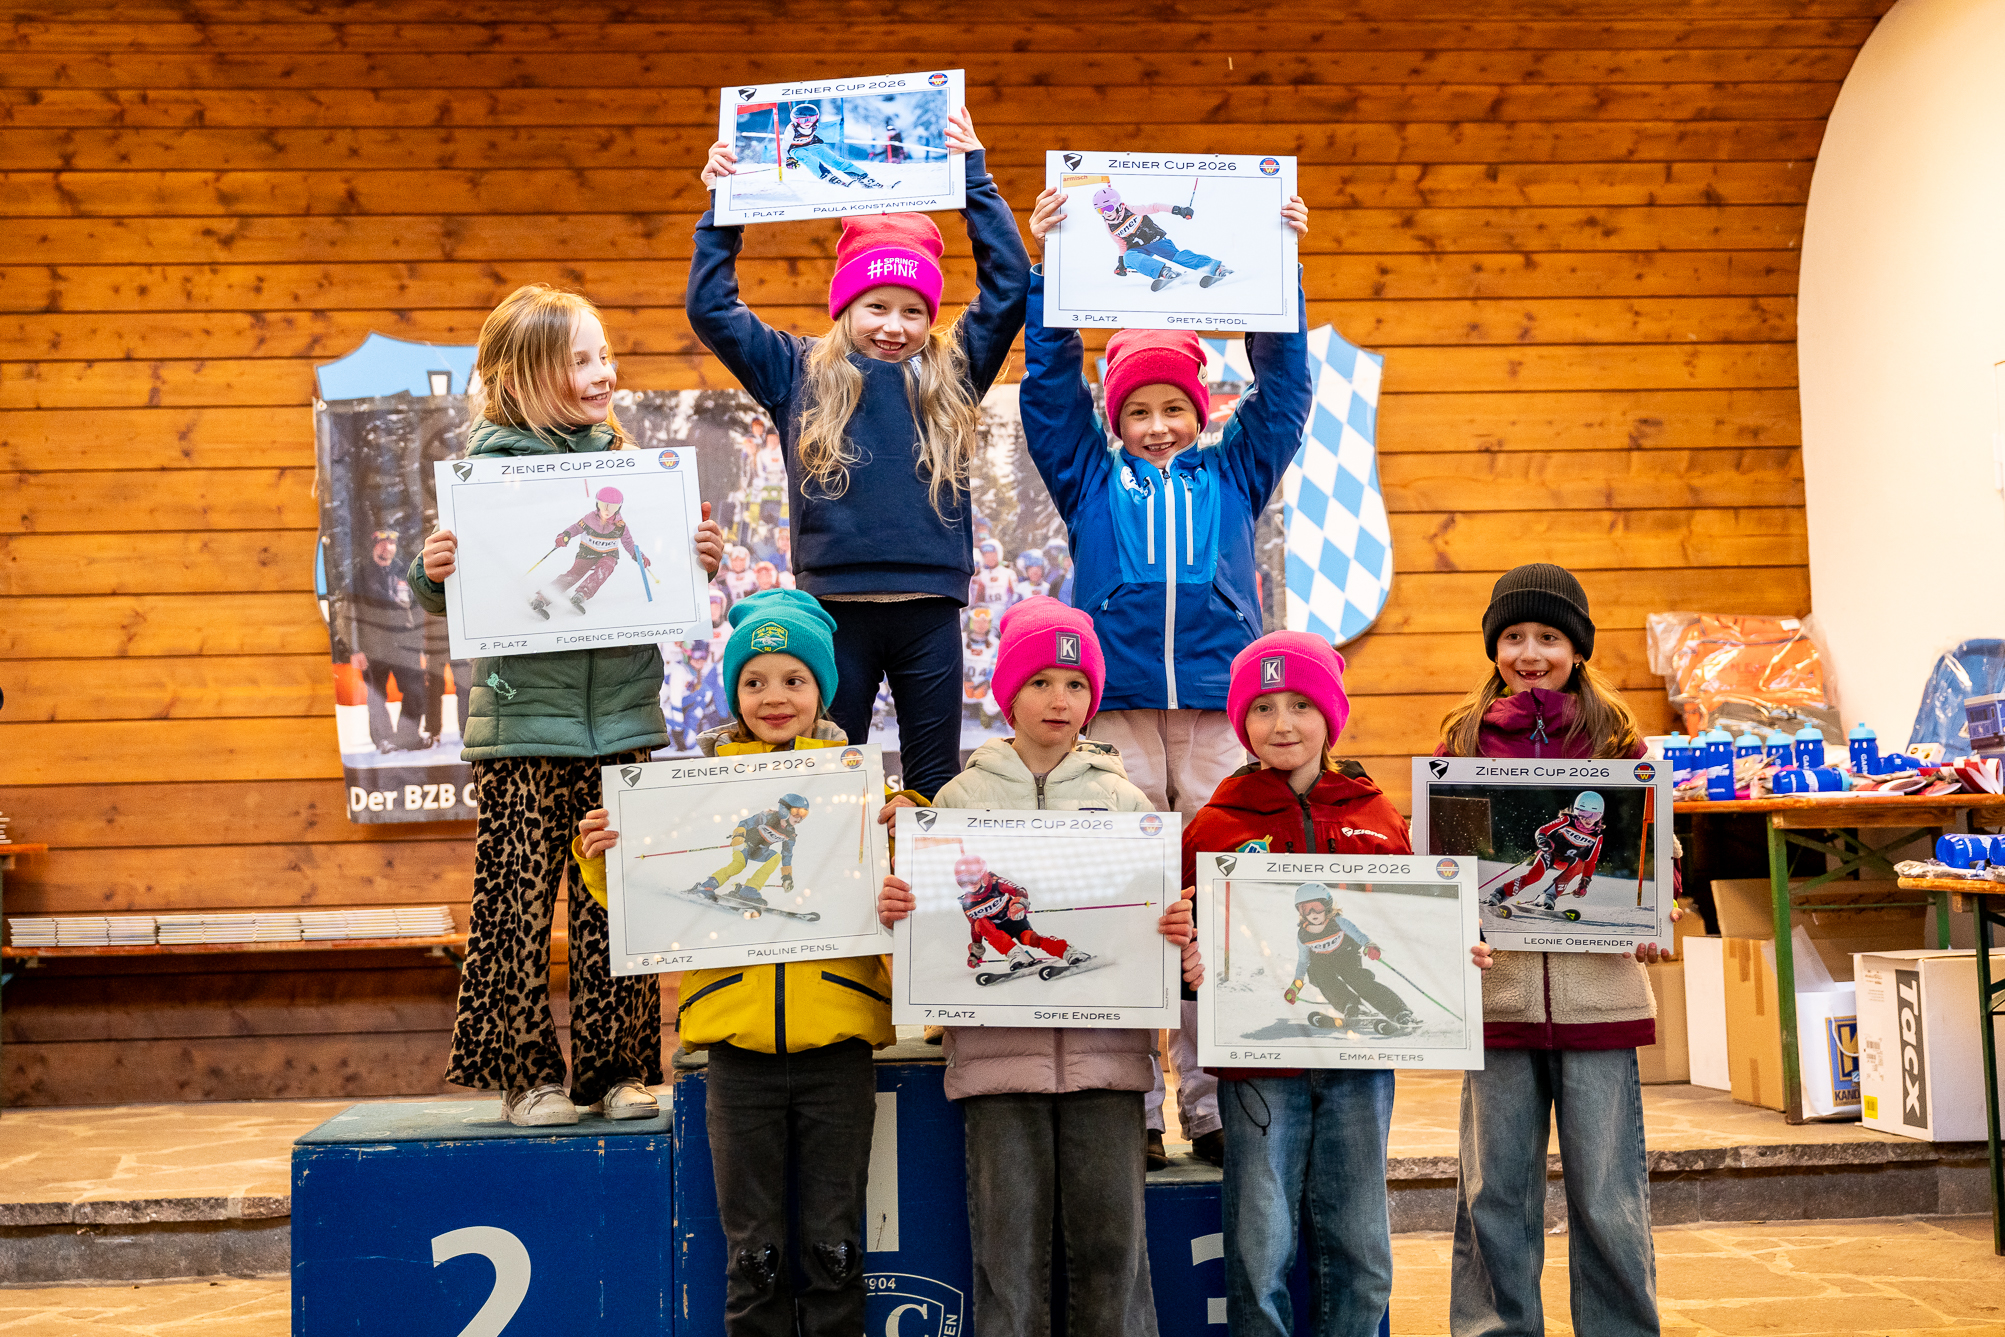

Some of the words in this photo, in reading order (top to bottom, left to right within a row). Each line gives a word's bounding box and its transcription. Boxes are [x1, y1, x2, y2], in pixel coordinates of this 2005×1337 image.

[782, 86, 832, 96] ZIENER
[836, 82, 866, 92] CUP
[868, 79, 906, 90] 2026
[1109, 160, 1159, 168] ZIENER
[1165, 161, 1194, 169] CUP
[1198, 162, 1236, 170] 2026
[813, 205, 848, 213] PAULA
[850, 199, 937, 211] KONSTANTINOVA
[752, 210, 786, 218] PLATZ
[883, 264, 917, 279] PINK
[1167, 316, 1203, 324] GRETA
[1205, 317, 1248, 325] STRODL
[502, 464, 555, 474] ZIENER
[560, 462, 591, 471] CUP
[596, 458, 635, 469] 2026
[556, 633, 615, 644] FLORENCE
[617, 628, 684, 640] PORSGAARD
[493, 640, 528, 649] PLATZ
[1062, 638, 1075, 658] K
[1266, 662, 1279, 681] K
[671, 766, 729, 779] ZIENER
[734, 763, 767, 773] CUP
[773, 758, 815, 770] 2026
[1476, 767, 1529, 776] ZIENER
[1534, 767, 1565, 776] CUP
[1569, 768, 1609, 777] 2026
[350, 786, 398, 812] Der
[404, 783, 456, 811] BZB
[968, 818, 1025, 828] ZIENER
[1031, 819, 1065, 829] CUP
[1070, 820, 1113, 830] 2026
[1267, 863, 1324, 872] ZIENER
[1330, 863, 1363, 873] CUP
[1368, 864, 1410, 874] 2026
[1524, 937, 1562, 945] LEONIE
[1566, 937, 1634, 947] OBERENDER
[747, 946, 797, 957] PAULINE
[801, 944, 839, 952] PENSL
[656, 955, 693, 965] PLATZ
[939, 1010, 975, 1018] PLATZ
[1034, 1011, 1068, 1019] SOFIE
[1073, 1012, 1120, 1020] ENDRES
[1899, 980, 1920, 1118] Tacx
[1378, 1053, 1423, 1061] PETERS
[431, 1226, 532, 1337] 2
[864, 1278, 896, 1290] 904
